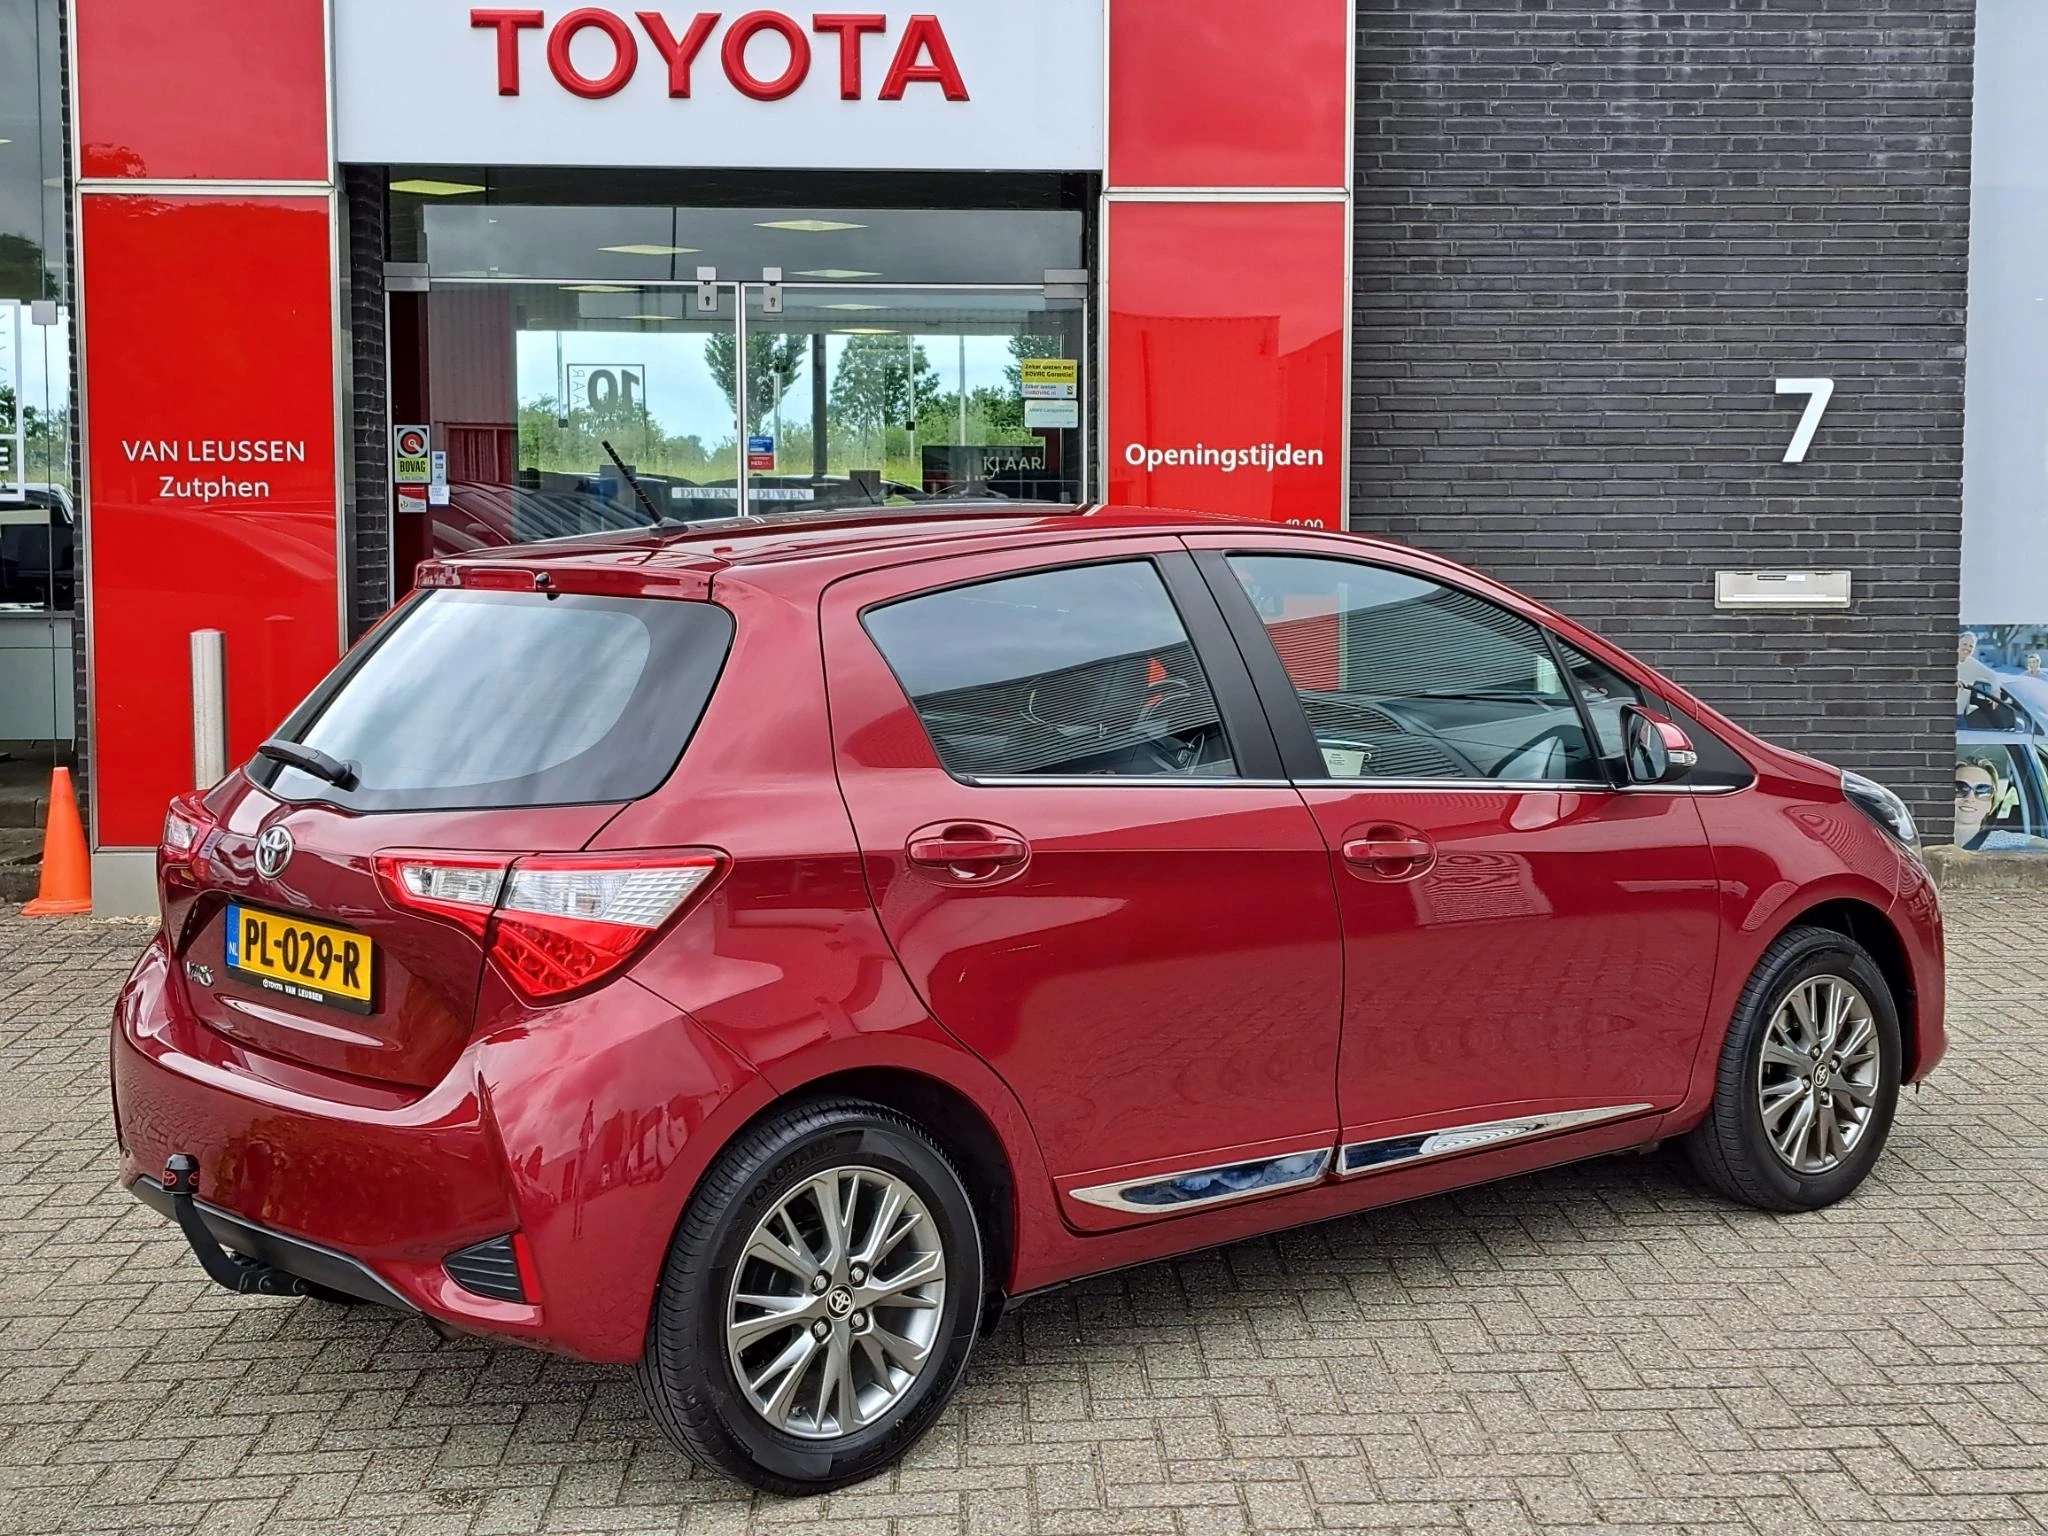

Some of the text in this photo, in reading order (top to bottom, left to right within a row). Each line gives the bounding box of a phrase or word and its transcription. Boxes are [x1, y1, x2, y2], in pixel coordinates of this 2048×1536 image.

[470, 7, 970, 101] TOYOTA
[1775, 378, 1835, 463] 7
[122, 440, 305, 462] VAN LEUSSEN
[1125, 443, 1324, 472] Openingstijden
[400, 461, 426, 473] BOVAG
[159, 475, 270, 502] Zutphen
[680, 488, 731, 498] DUWEN
[756, 489, 807, 500] DUWEN
[228, 941, 238, 957] NL
[245, 917, 360, 989] PL-029-R
[284, 985, 296, 995] VAN
[298, 988, 324, 1002] LEUSSEN
